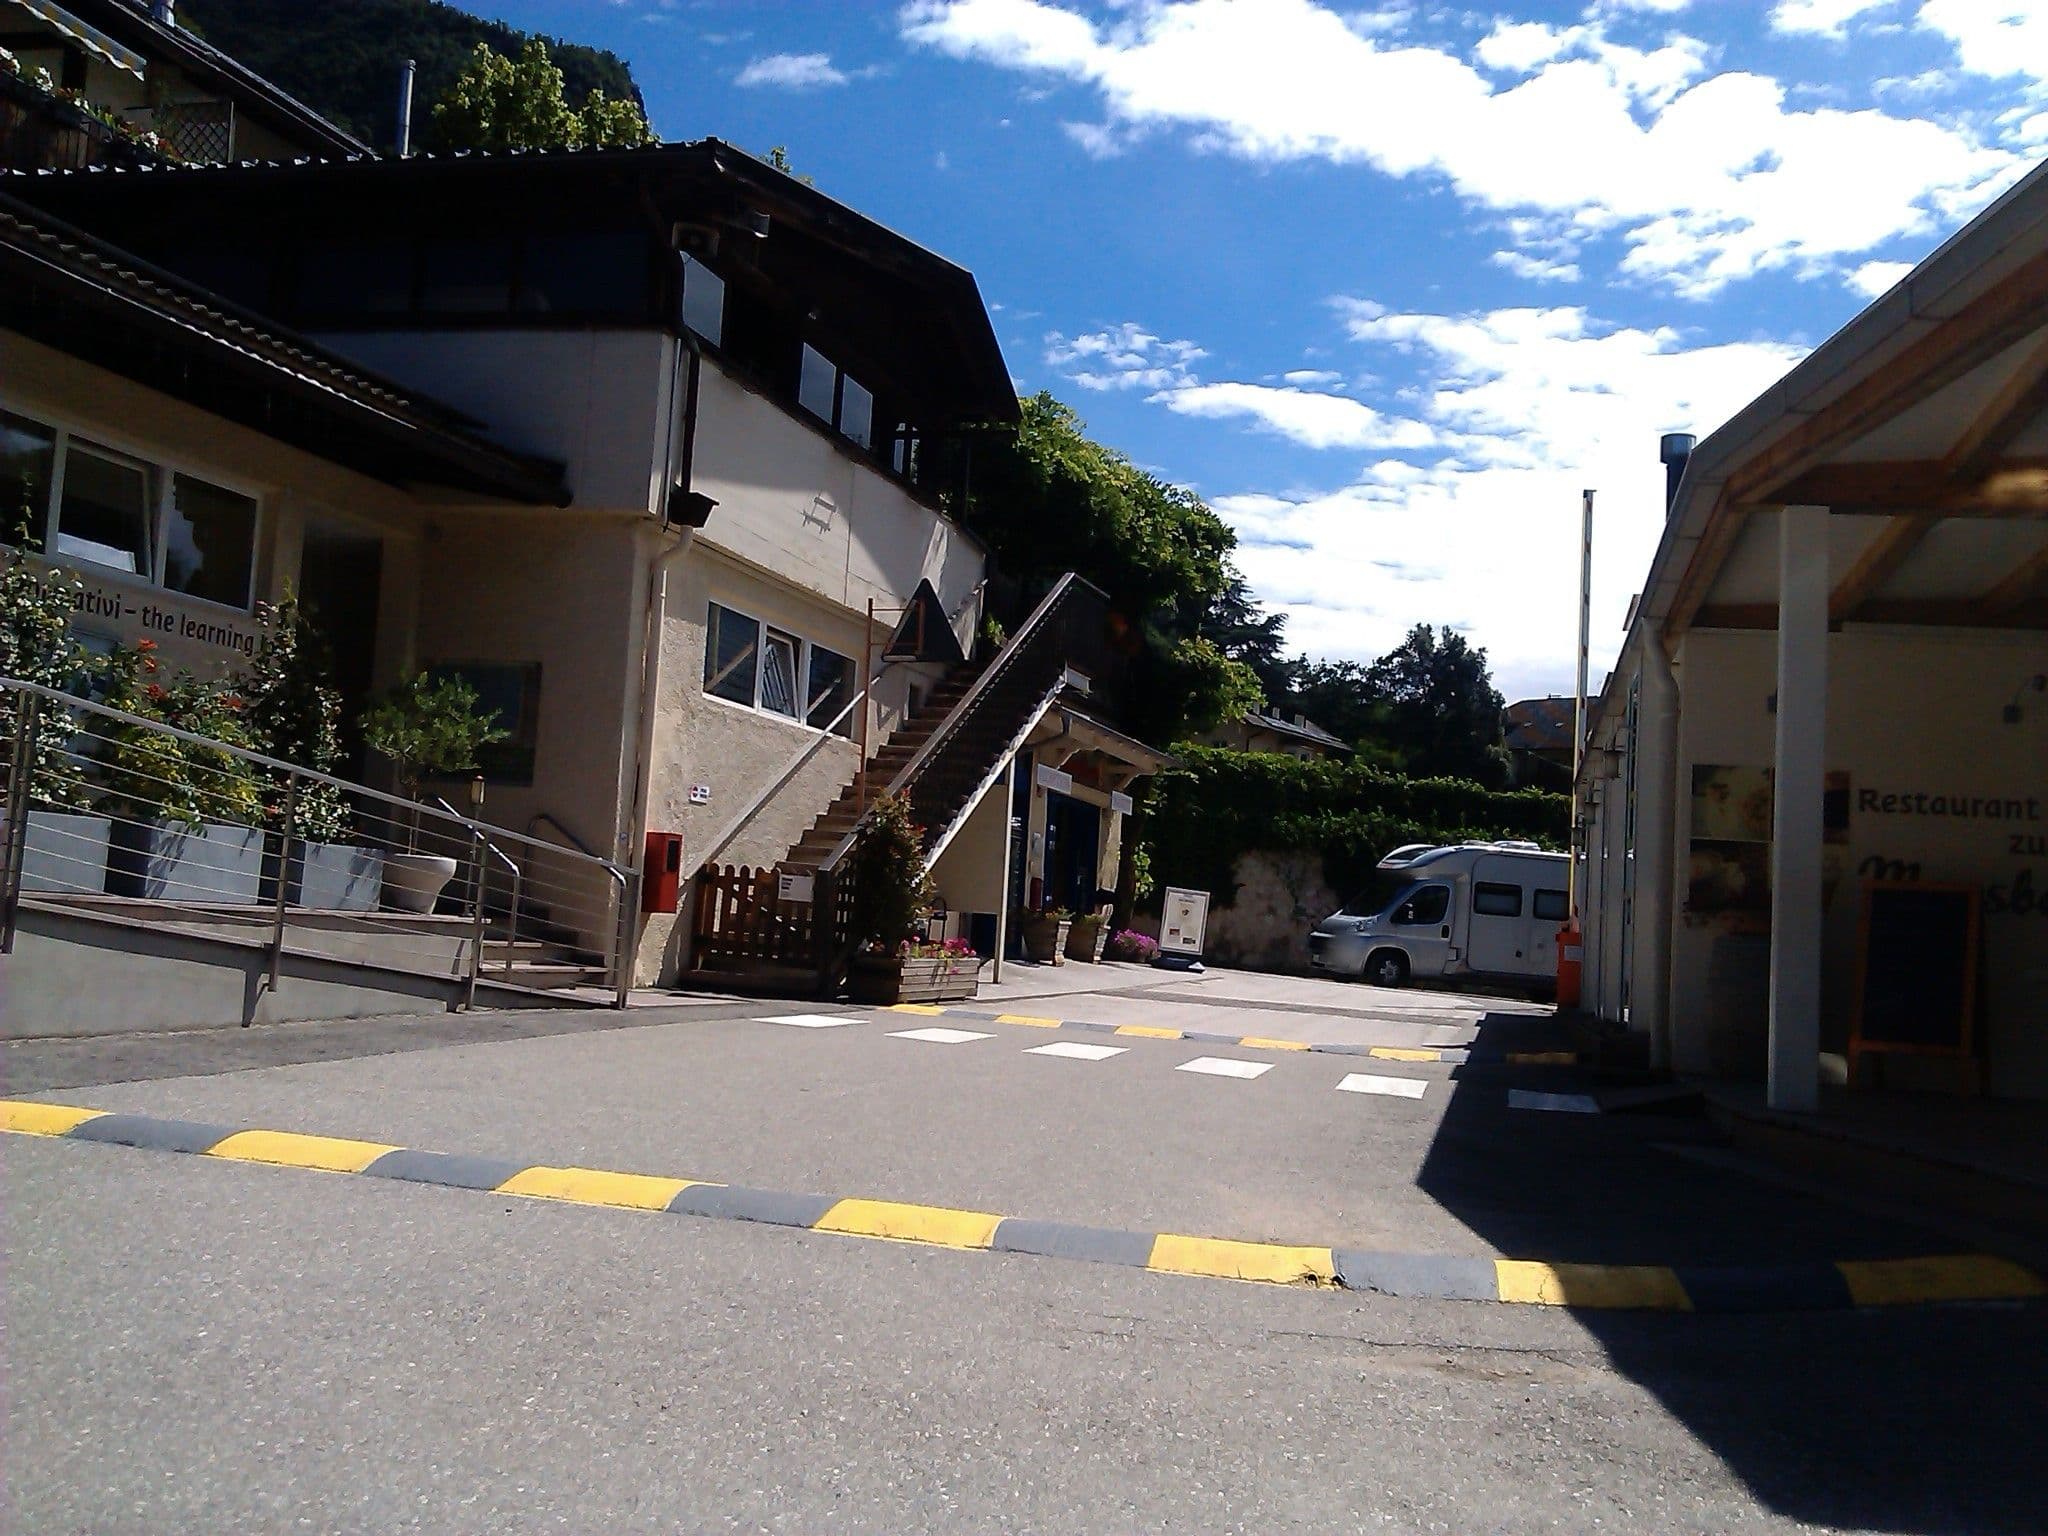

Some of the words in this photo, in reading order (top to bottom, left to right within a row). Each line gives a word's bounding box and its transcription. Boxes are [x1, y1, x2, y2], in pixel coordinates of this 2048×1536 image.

[142, 605, 174, 632] the
[180, 613, 255, 657] learning
[1858, 788, 2040, 822] Restaurant
